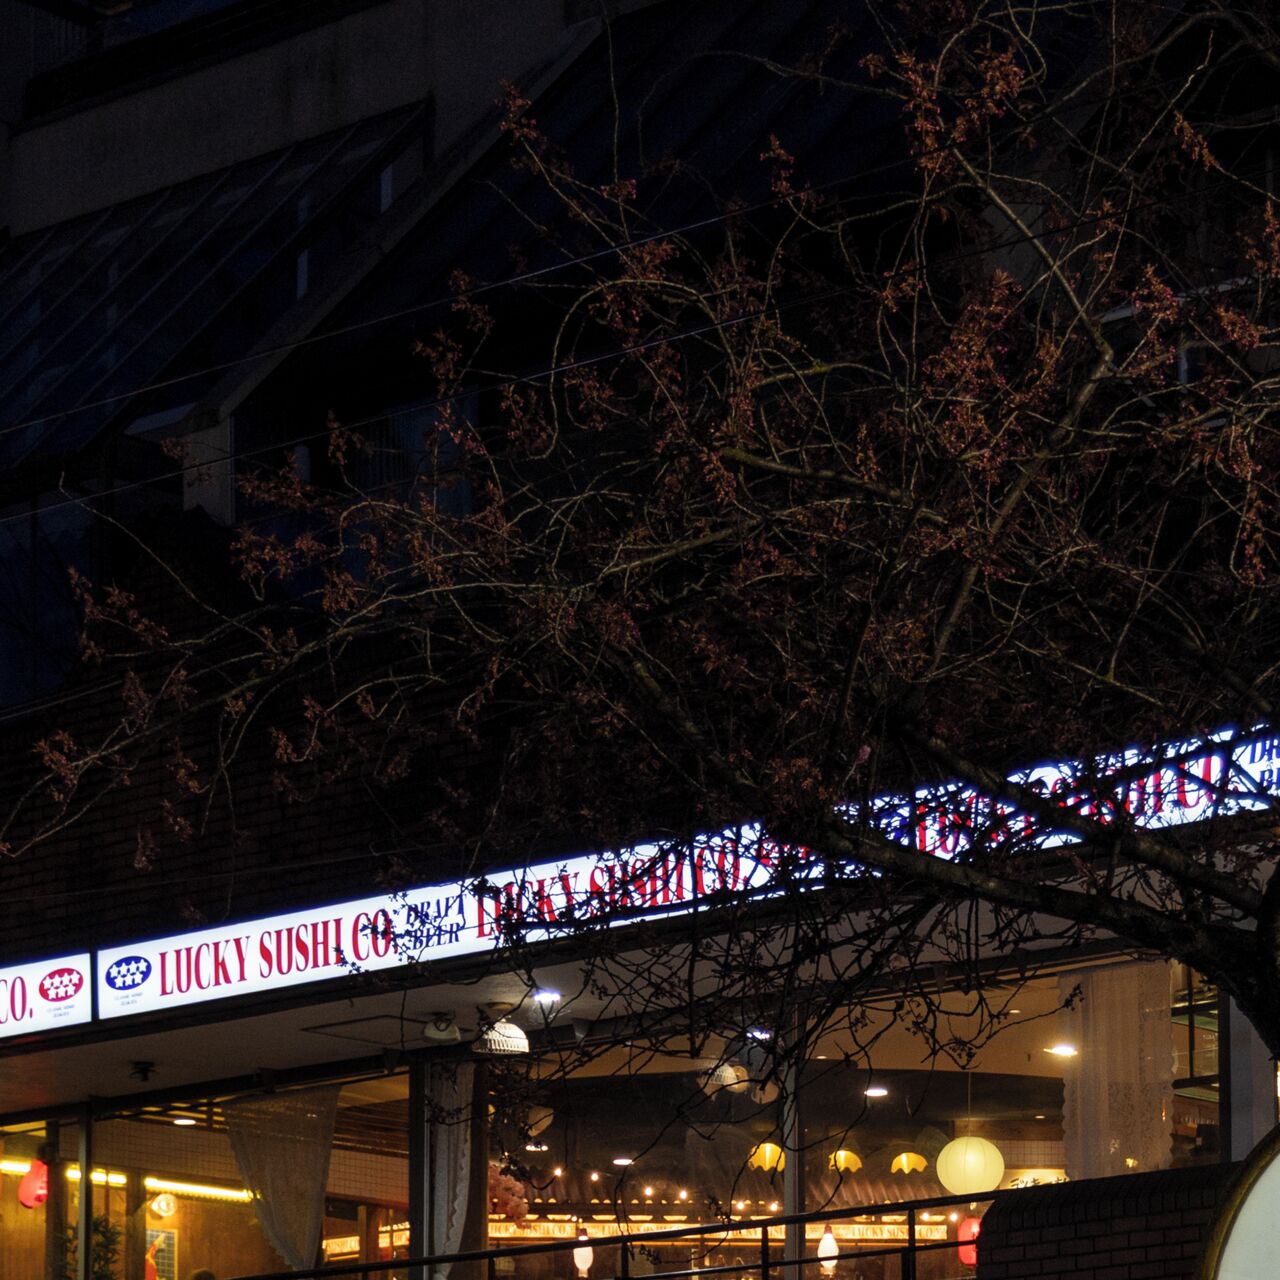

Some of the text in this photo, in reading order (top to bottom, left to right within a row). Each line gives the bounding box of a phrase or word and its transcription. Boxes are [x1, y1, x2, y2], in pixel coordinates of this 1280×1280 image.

[159, 908, 399, 996] LUCKY SUSHI CO.
